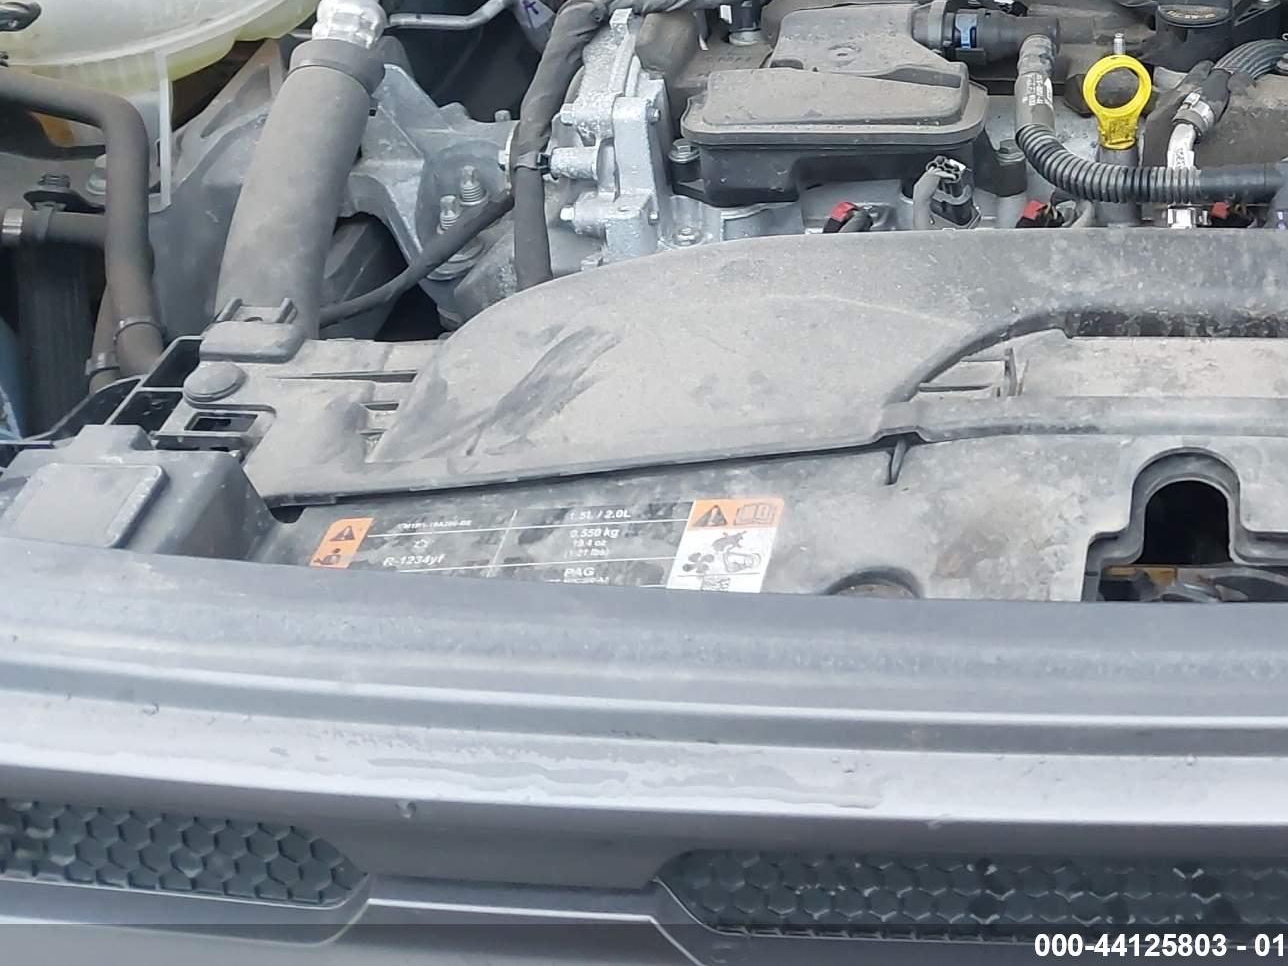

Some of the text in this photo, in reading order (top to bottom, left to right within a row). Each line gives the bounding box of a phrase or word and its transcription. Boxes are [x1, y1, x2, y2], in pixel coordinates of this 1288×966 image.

[604, 509, 631, 519] 2.0L
[569, 526, 620, 539] 0.550 kg
[594, 539, 608, 547] oz
[383, 553, 446, 566] R-1234yf
[563, 566, 595, 578] PAG
